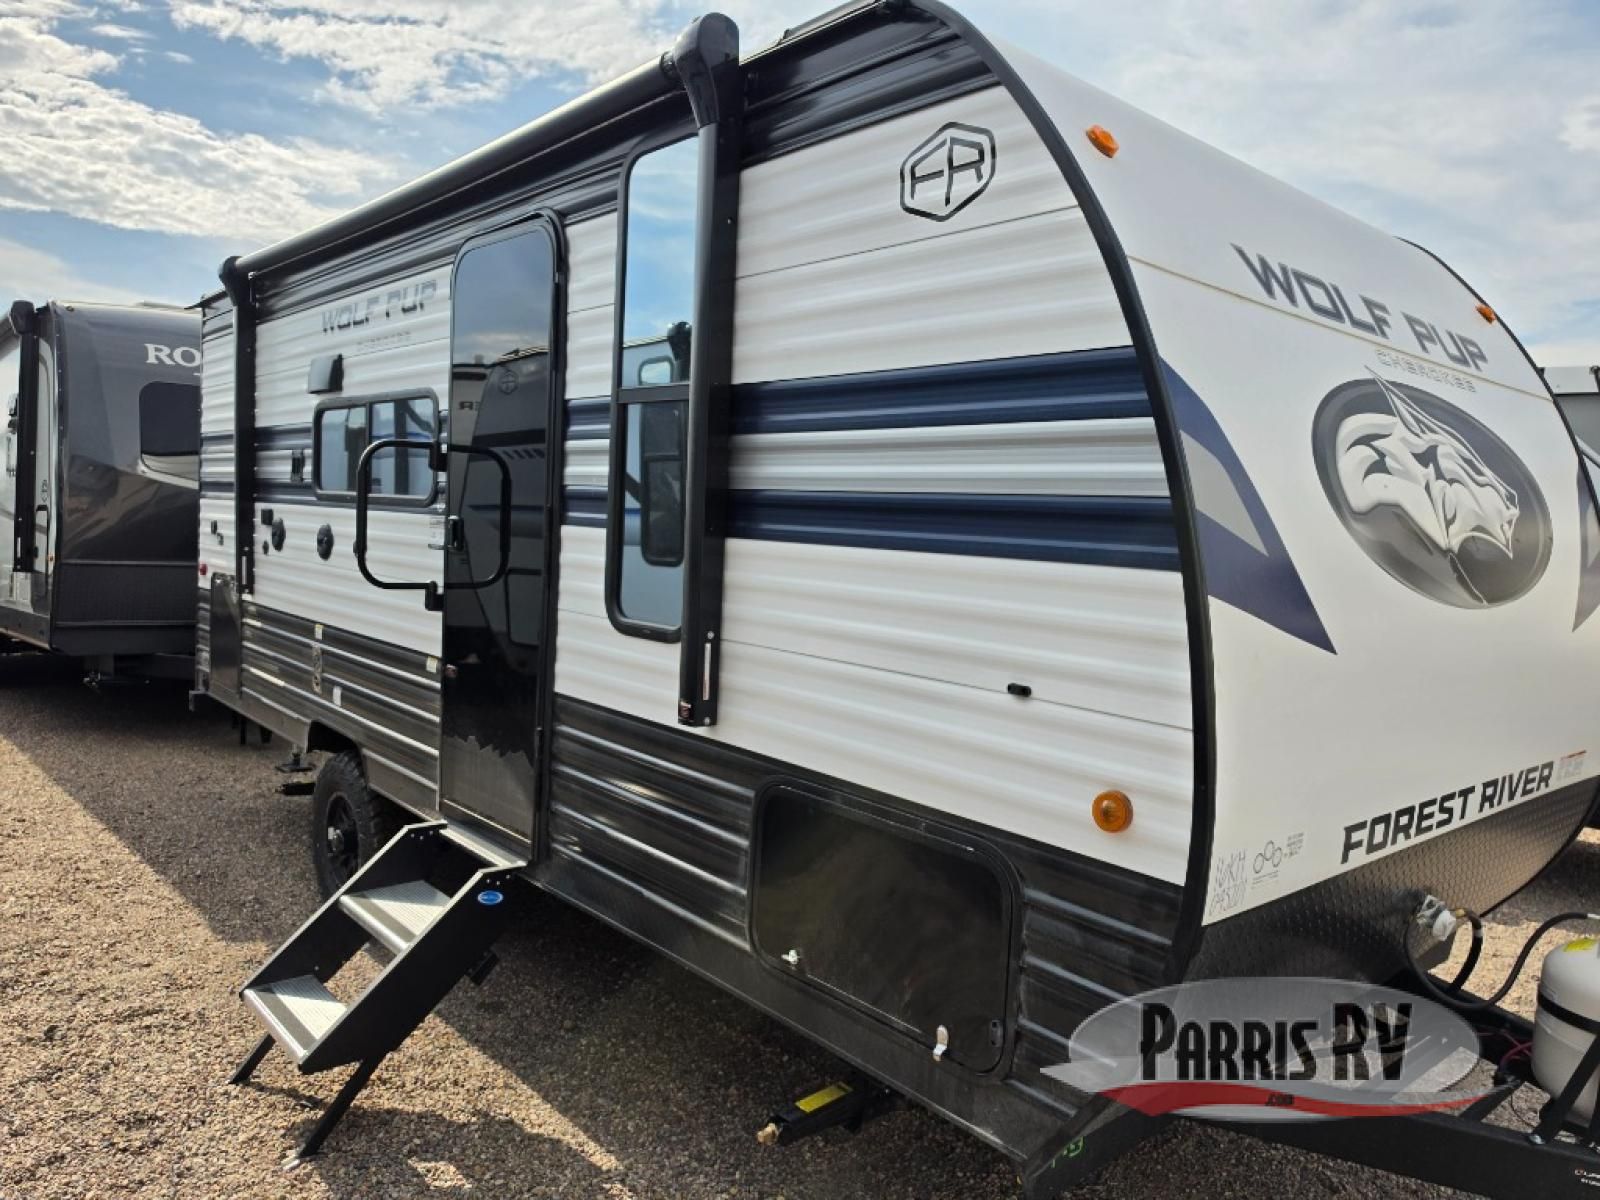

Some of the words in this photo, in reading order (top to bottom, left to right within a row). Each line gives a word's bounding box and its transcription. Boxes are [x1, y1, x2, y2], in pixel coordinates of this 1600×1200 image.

[322, 297, 380, 333] WOLF
[385, 280, 437, 318] PUP
[1230, 243, 1392, 340] WOLF
[1401, 311, 1488, 372] PUP
[1341, 785, 1476, 864] FOREST
[1478, 761, 1554, 813] RIVER
